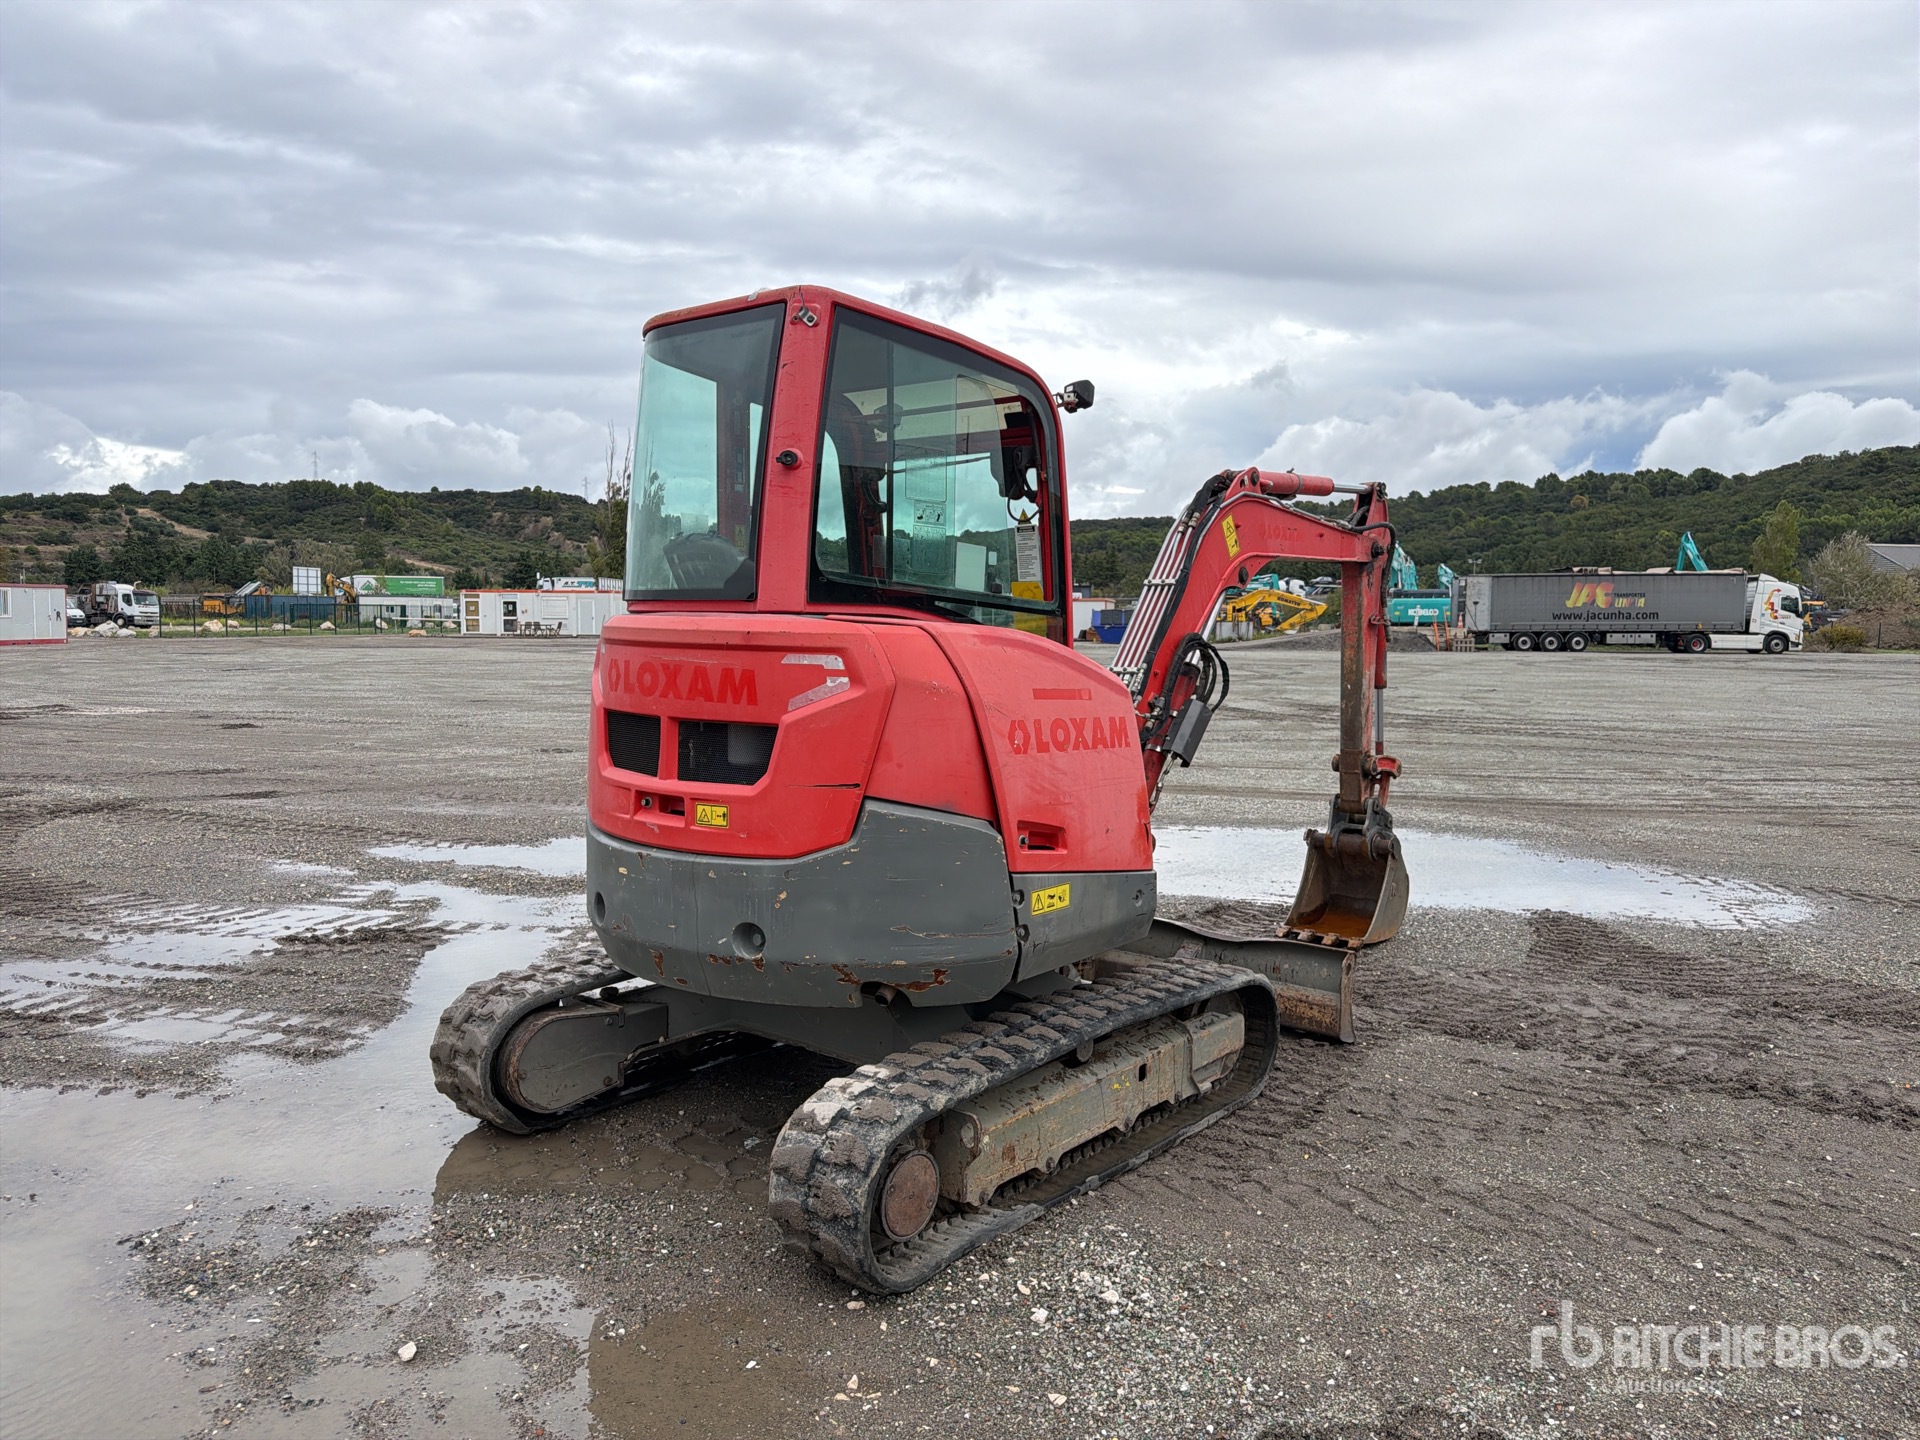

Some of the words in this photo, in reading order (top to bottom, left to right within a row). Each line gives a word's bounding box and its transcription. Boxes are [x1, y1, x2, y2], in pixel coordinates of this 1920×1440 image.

[1277, 595, 1302, 607] KOMATSU
[1552, 610, 1659, 622] www.jacunha.com
[623, 658, 759, 707] LOXAM
[1034, 716, 1131, 754] LOXAM
